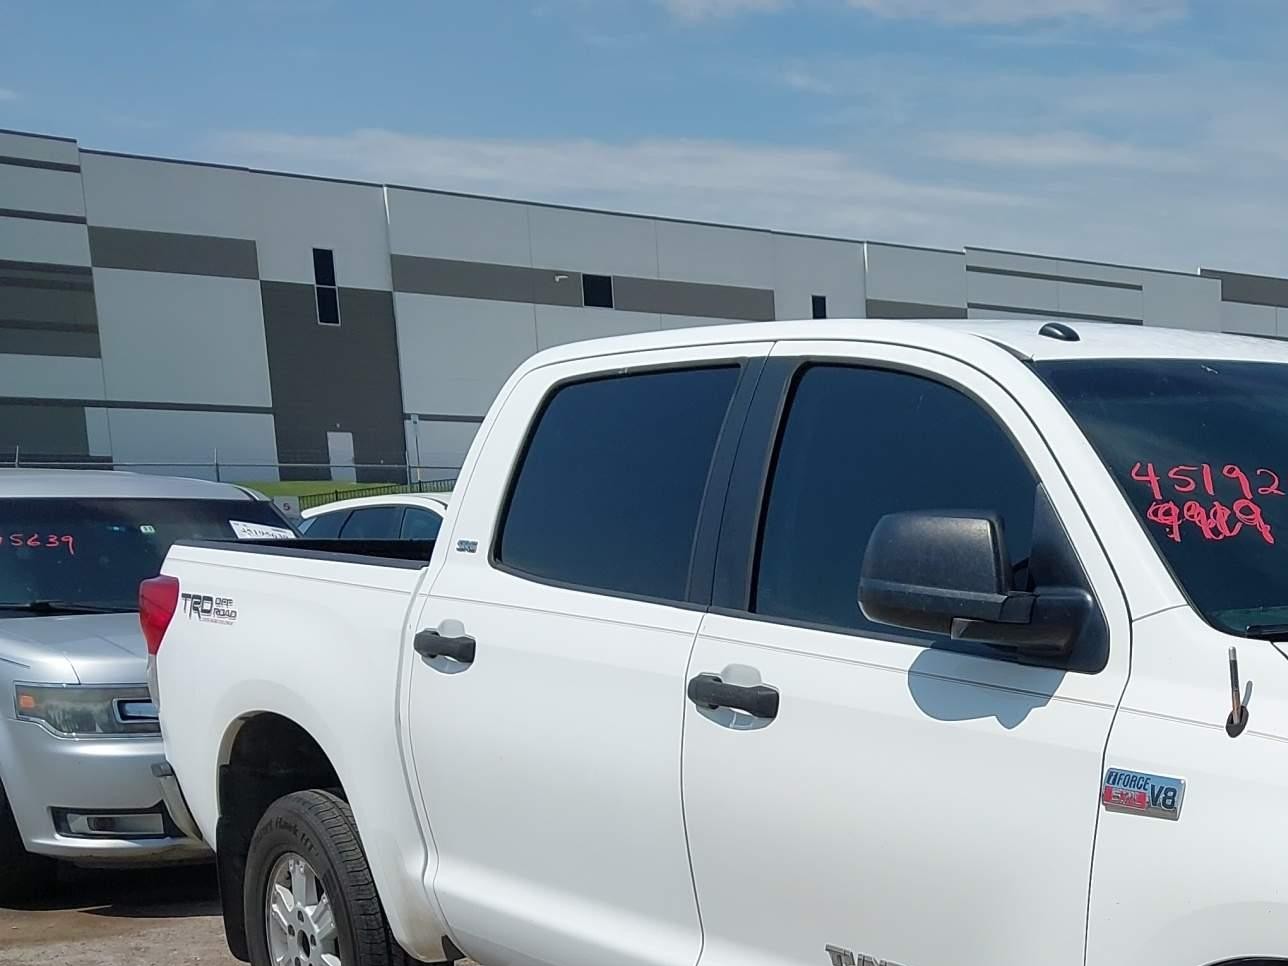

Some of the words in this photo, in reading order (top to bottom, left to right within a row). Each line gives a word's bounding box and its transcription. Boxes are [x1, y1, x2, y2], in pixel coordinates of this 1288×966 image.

[0, 533, 75, 556] 5639
[181, 592, 214, 621] TRD
[215, 597, 233, 607] OFF
[213, 607, 238, 619] ROAD
[1145, 782, 1178, 811] V8
